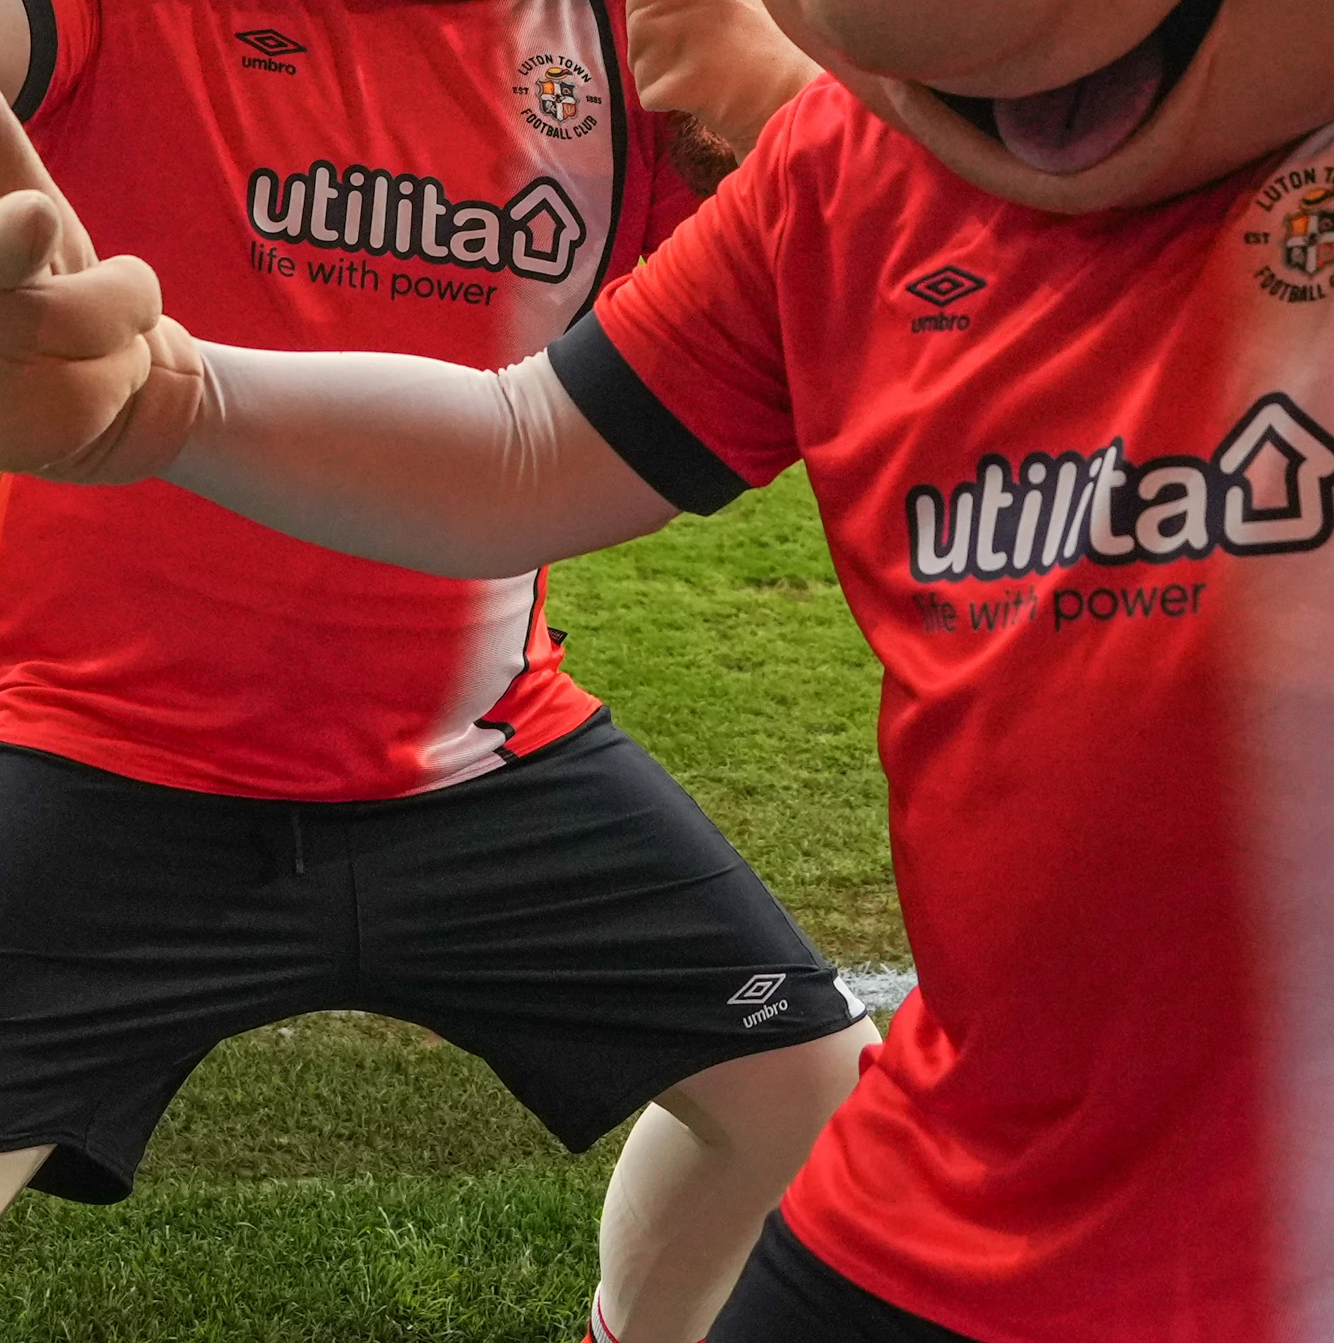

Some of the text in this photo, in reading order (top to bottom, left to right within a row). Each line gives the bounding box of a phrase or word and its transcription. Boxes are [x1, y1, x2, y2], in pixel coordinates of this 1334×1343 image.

[242, 56, 296, 76] umbro
[517, 54, 592, 83] LUTON TOWN
[512, 86, 529, 95] EST
[586, 95, 602, 105] 1885
[521, 108, 597, 140] FOOTBALL CLUB
[1255, 168, 1316, 213] LUTON
[247, 160, 507, 270] utilita
[250, 240, 498, 306] life with power
[911, 312, 970, 334] umbro
[906, 435, 1217, 583] utilita
[1054, 580, 1207, 633] power
[742, 999, 788, 1029] umbro
